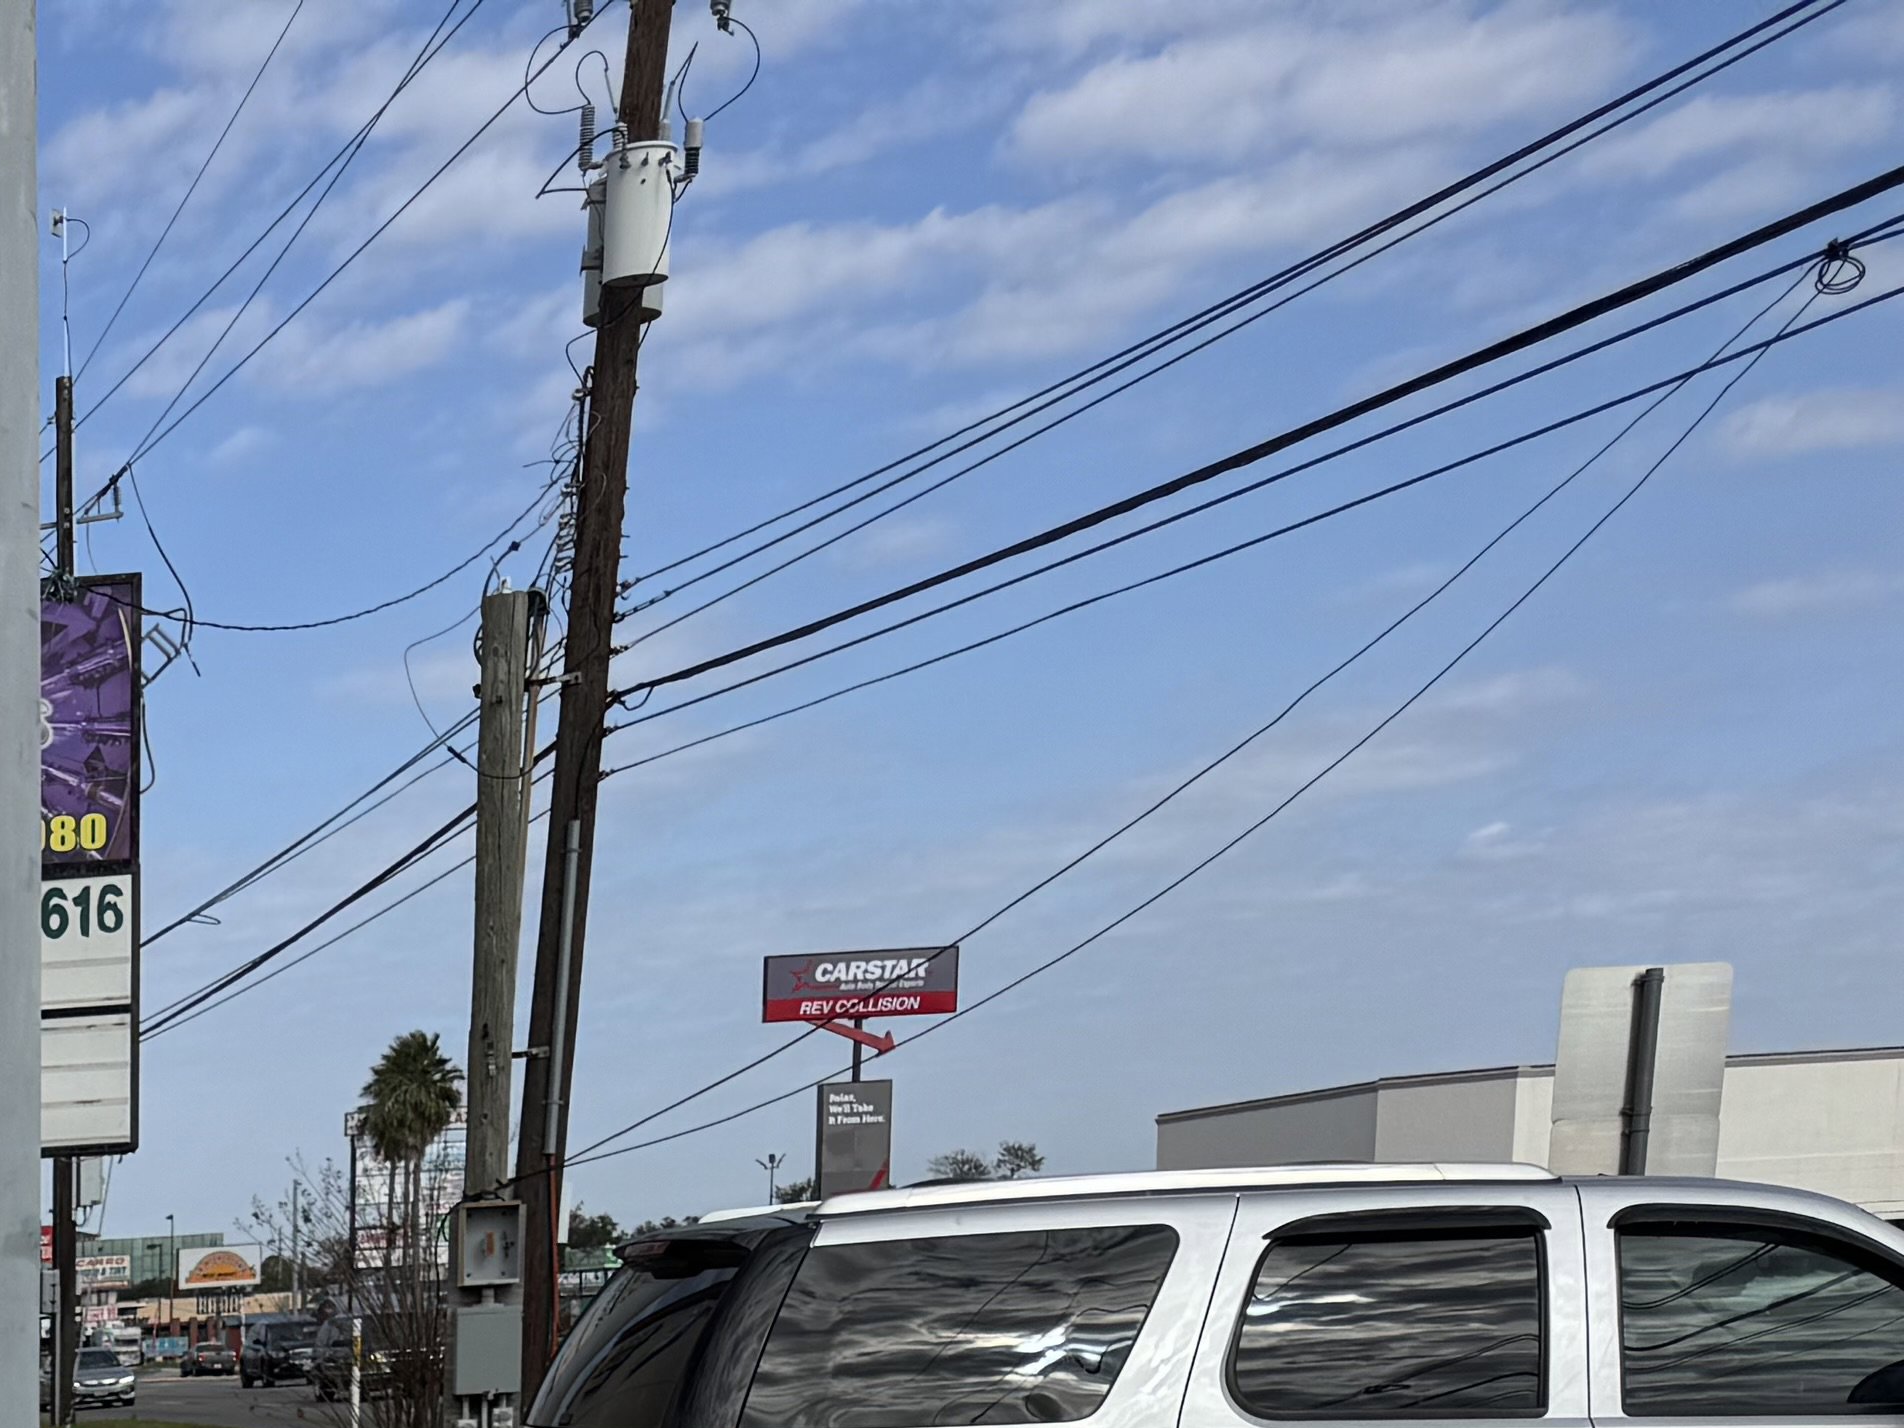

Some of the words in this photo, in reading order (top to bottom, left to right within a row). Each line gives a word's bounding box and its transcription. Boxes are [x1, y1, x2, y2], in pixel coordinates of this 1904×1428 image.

[814, 957, 930, 983] CARSTAR
[799, 1000, 836, 1016] REV
[835, 996, 921, 1014] COLLISION
